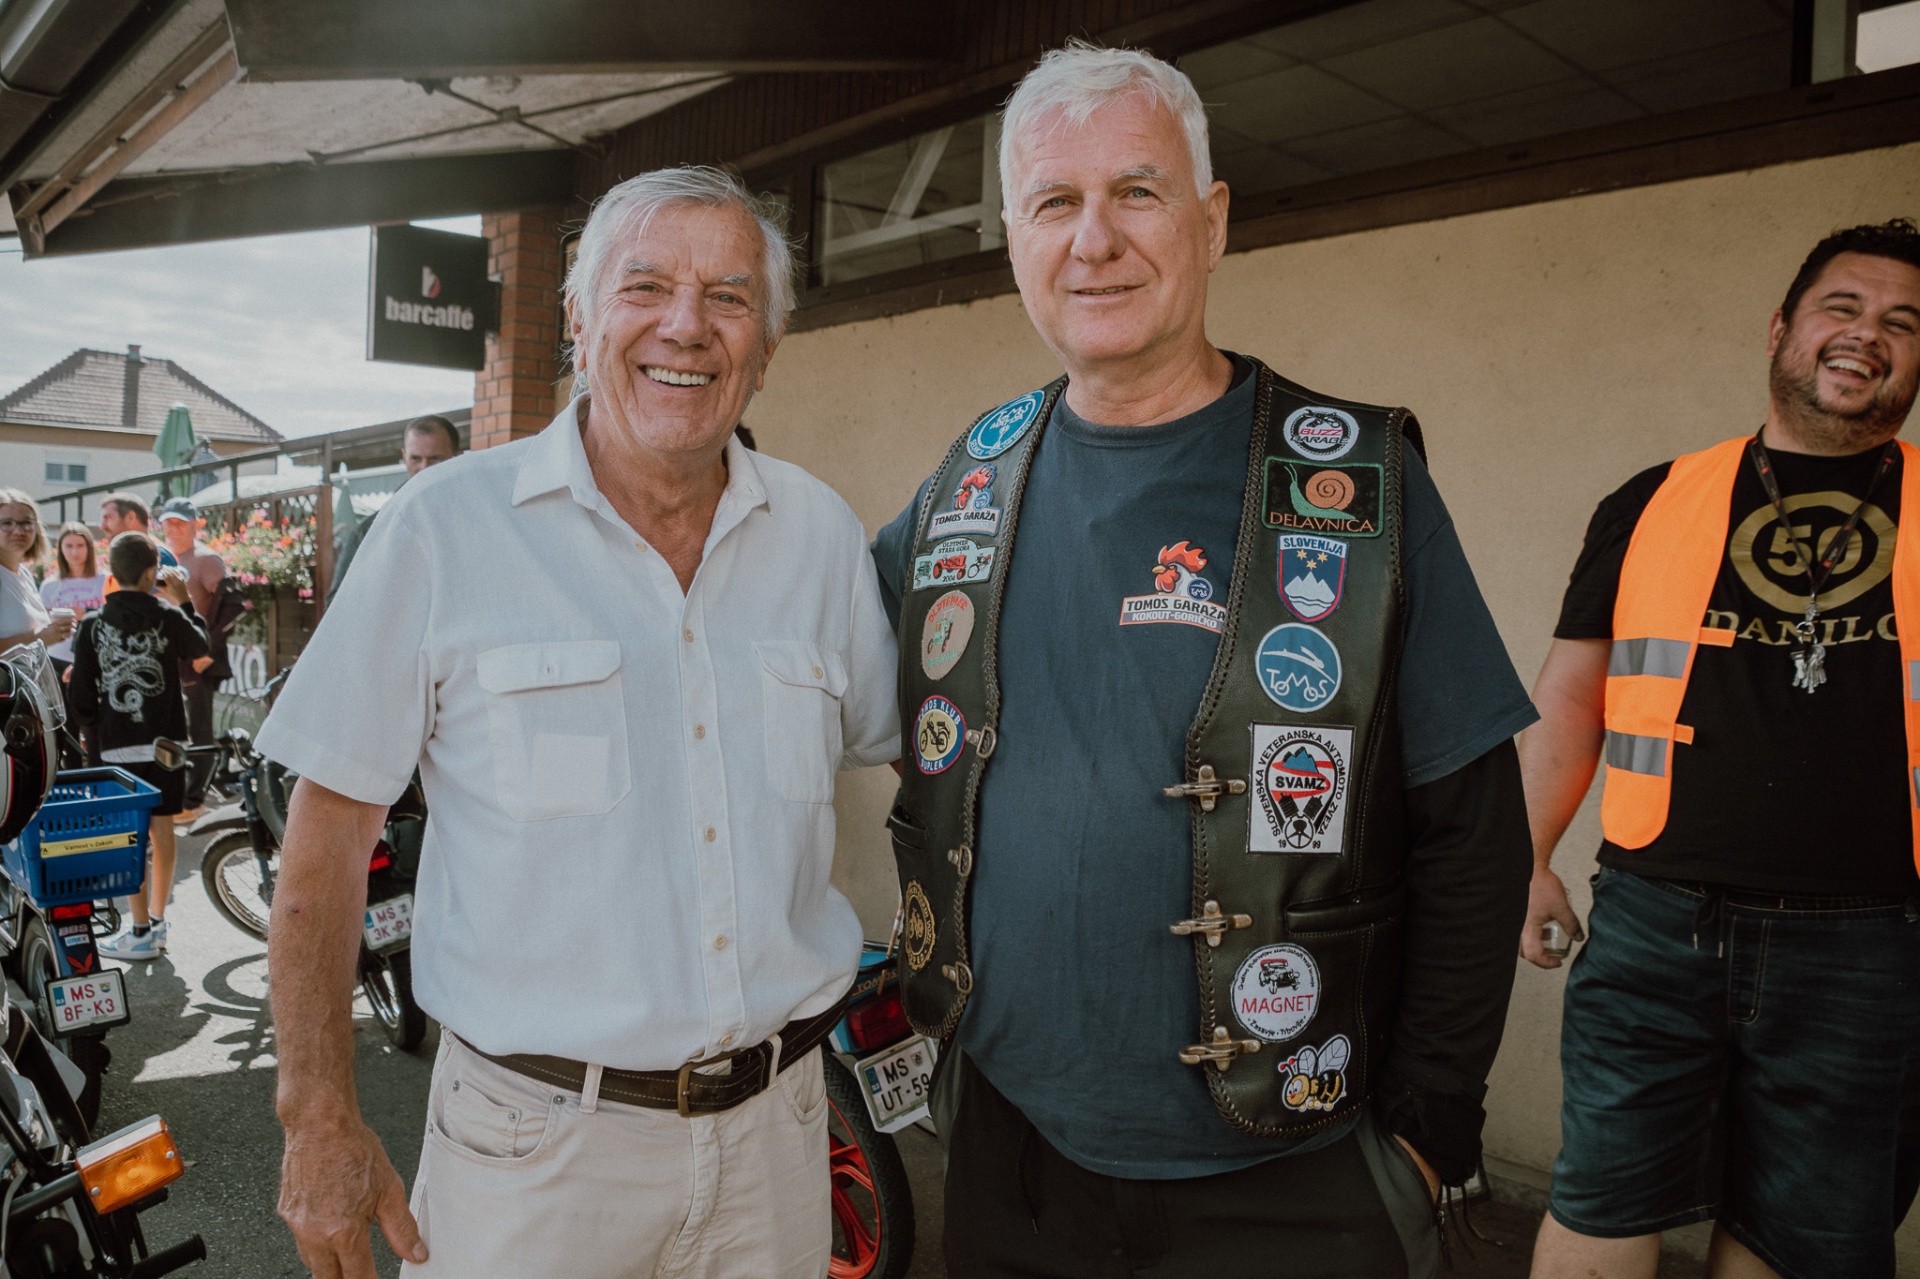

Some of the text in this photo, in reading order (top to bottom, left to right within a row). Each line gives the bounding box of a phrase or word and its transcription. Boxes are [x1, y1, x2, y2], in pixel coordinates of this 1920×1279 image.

[1290, 435, 1350, 444] GARAGE
[1300, 428, 1344, 436] BUZZ
[935, 509, 996, 526] TOMOS GARAŽA
[1270, 511, 1375, 533] DELAVNICA
[1283, 537, 1344, 556] SLOVENIJA
[1767, 524, 1863, 576] 50
[1127, 598, 1226, 621] TOMOS GARAŽA
[1132, 611, 1217, 629] KOKOUT-GORIČKO
[941, 699, 961, 725] KLUB
[1255, 730, 1345, 837] SLOVENSKA VETERANSKA AVTOMOTO ZVEZA
[1276, 776, 1325, 790] SVAMZ
[1278, 839, 1287, 848] 19
[375, 907, 396, 923] MS
[70, 984, 95, 1001] MS
[64, 998, 115, 1022] 8F-K3
[1241, 994, 1314, 1014] MAGNET
[882, 1058, 909, 1084] MS
